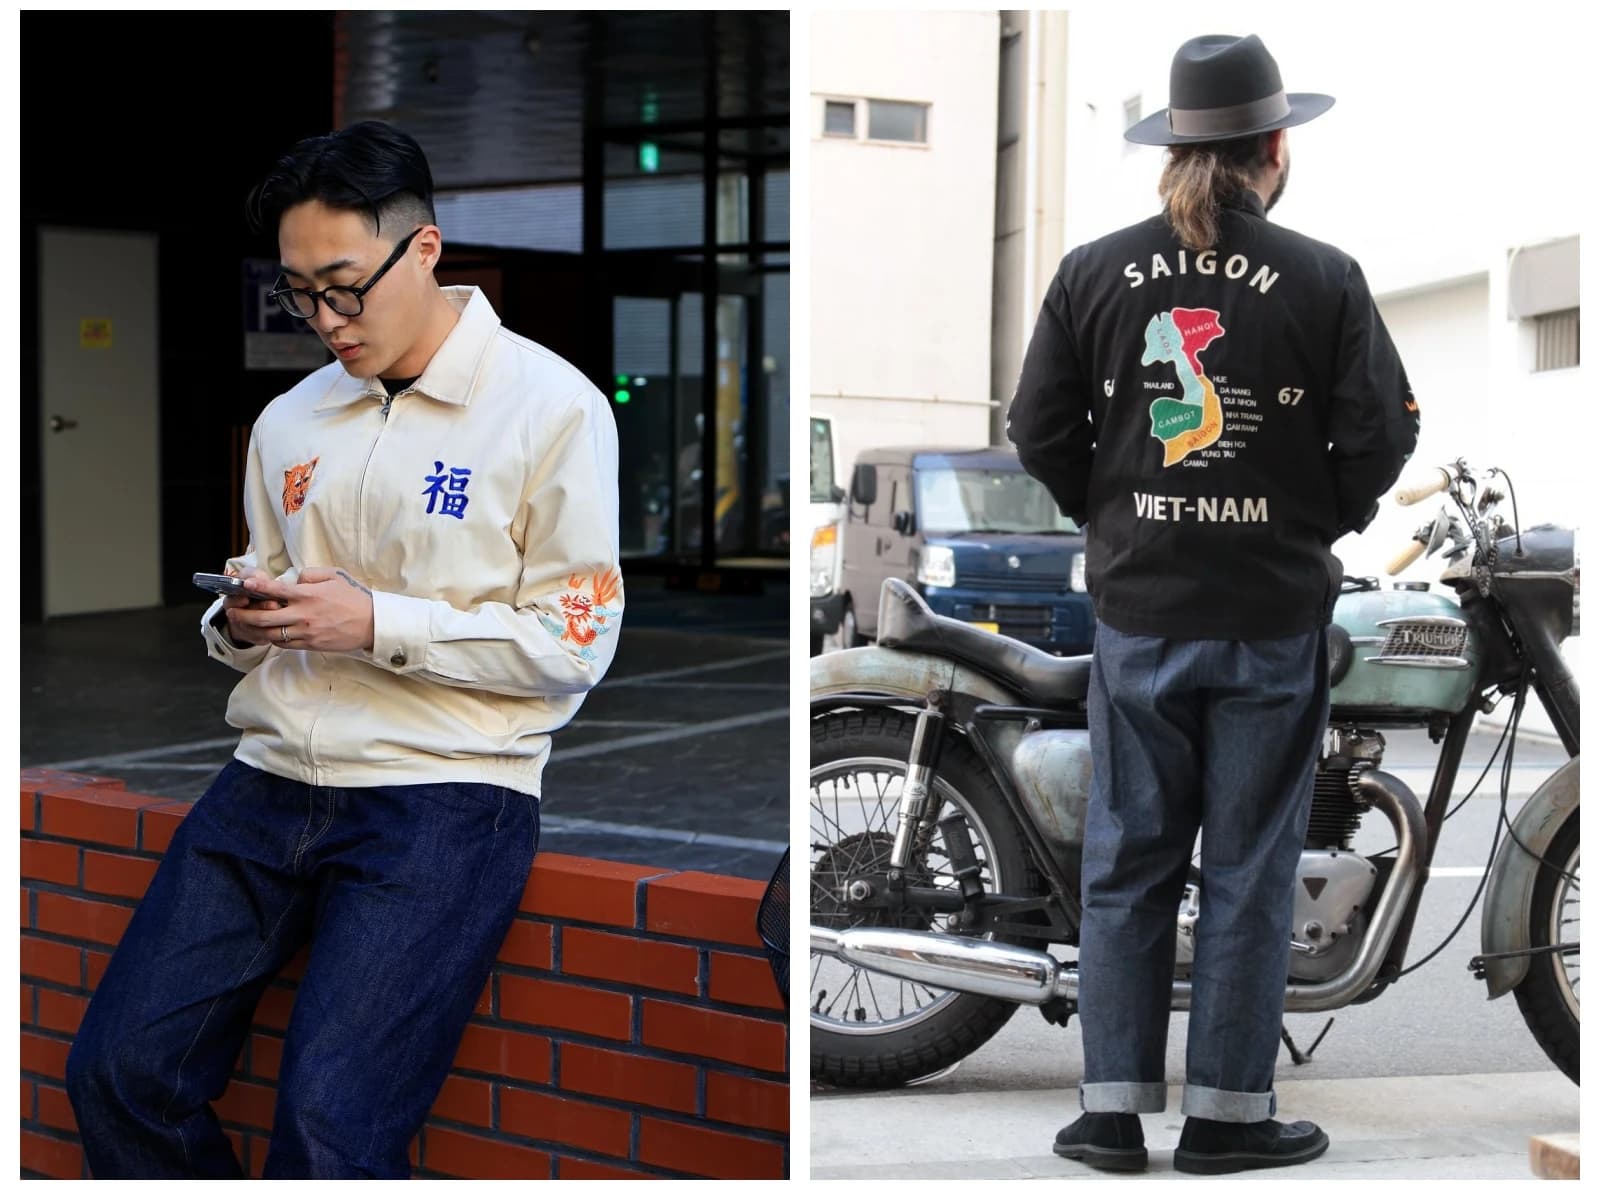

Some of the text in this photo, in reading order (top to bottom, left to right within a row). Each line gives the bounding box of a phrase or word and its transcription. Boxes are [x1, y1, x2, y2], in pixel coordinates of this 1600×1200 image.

[1123, 249, 1280, 294] SAIGON
[1184, 322, 1215, 337] HANOI
[1156, 327, 1172, 355] LAOS
[1143, 382, 1175, 390] THAILAND
[1212, 376, 1228, 384] HUE
[1231, 388, 1252, 396] NANG
[1278, 387, 1304, 407] 67
[1223, 397, 1257, 408] QUI NHON
[1240, 412, 1263, 422] TRANG
[1187, 421, 1219, 448] SAIGON
[1201, 450, 1236, 458] VUNG TAU
[1183, 460, 1208, 468] CAMAU
[421, 460, 472, 520] 福
[1133, 492, 1269, 523] VIET-NAM
[1402, 630, 1462, 650] TRIUMPH
